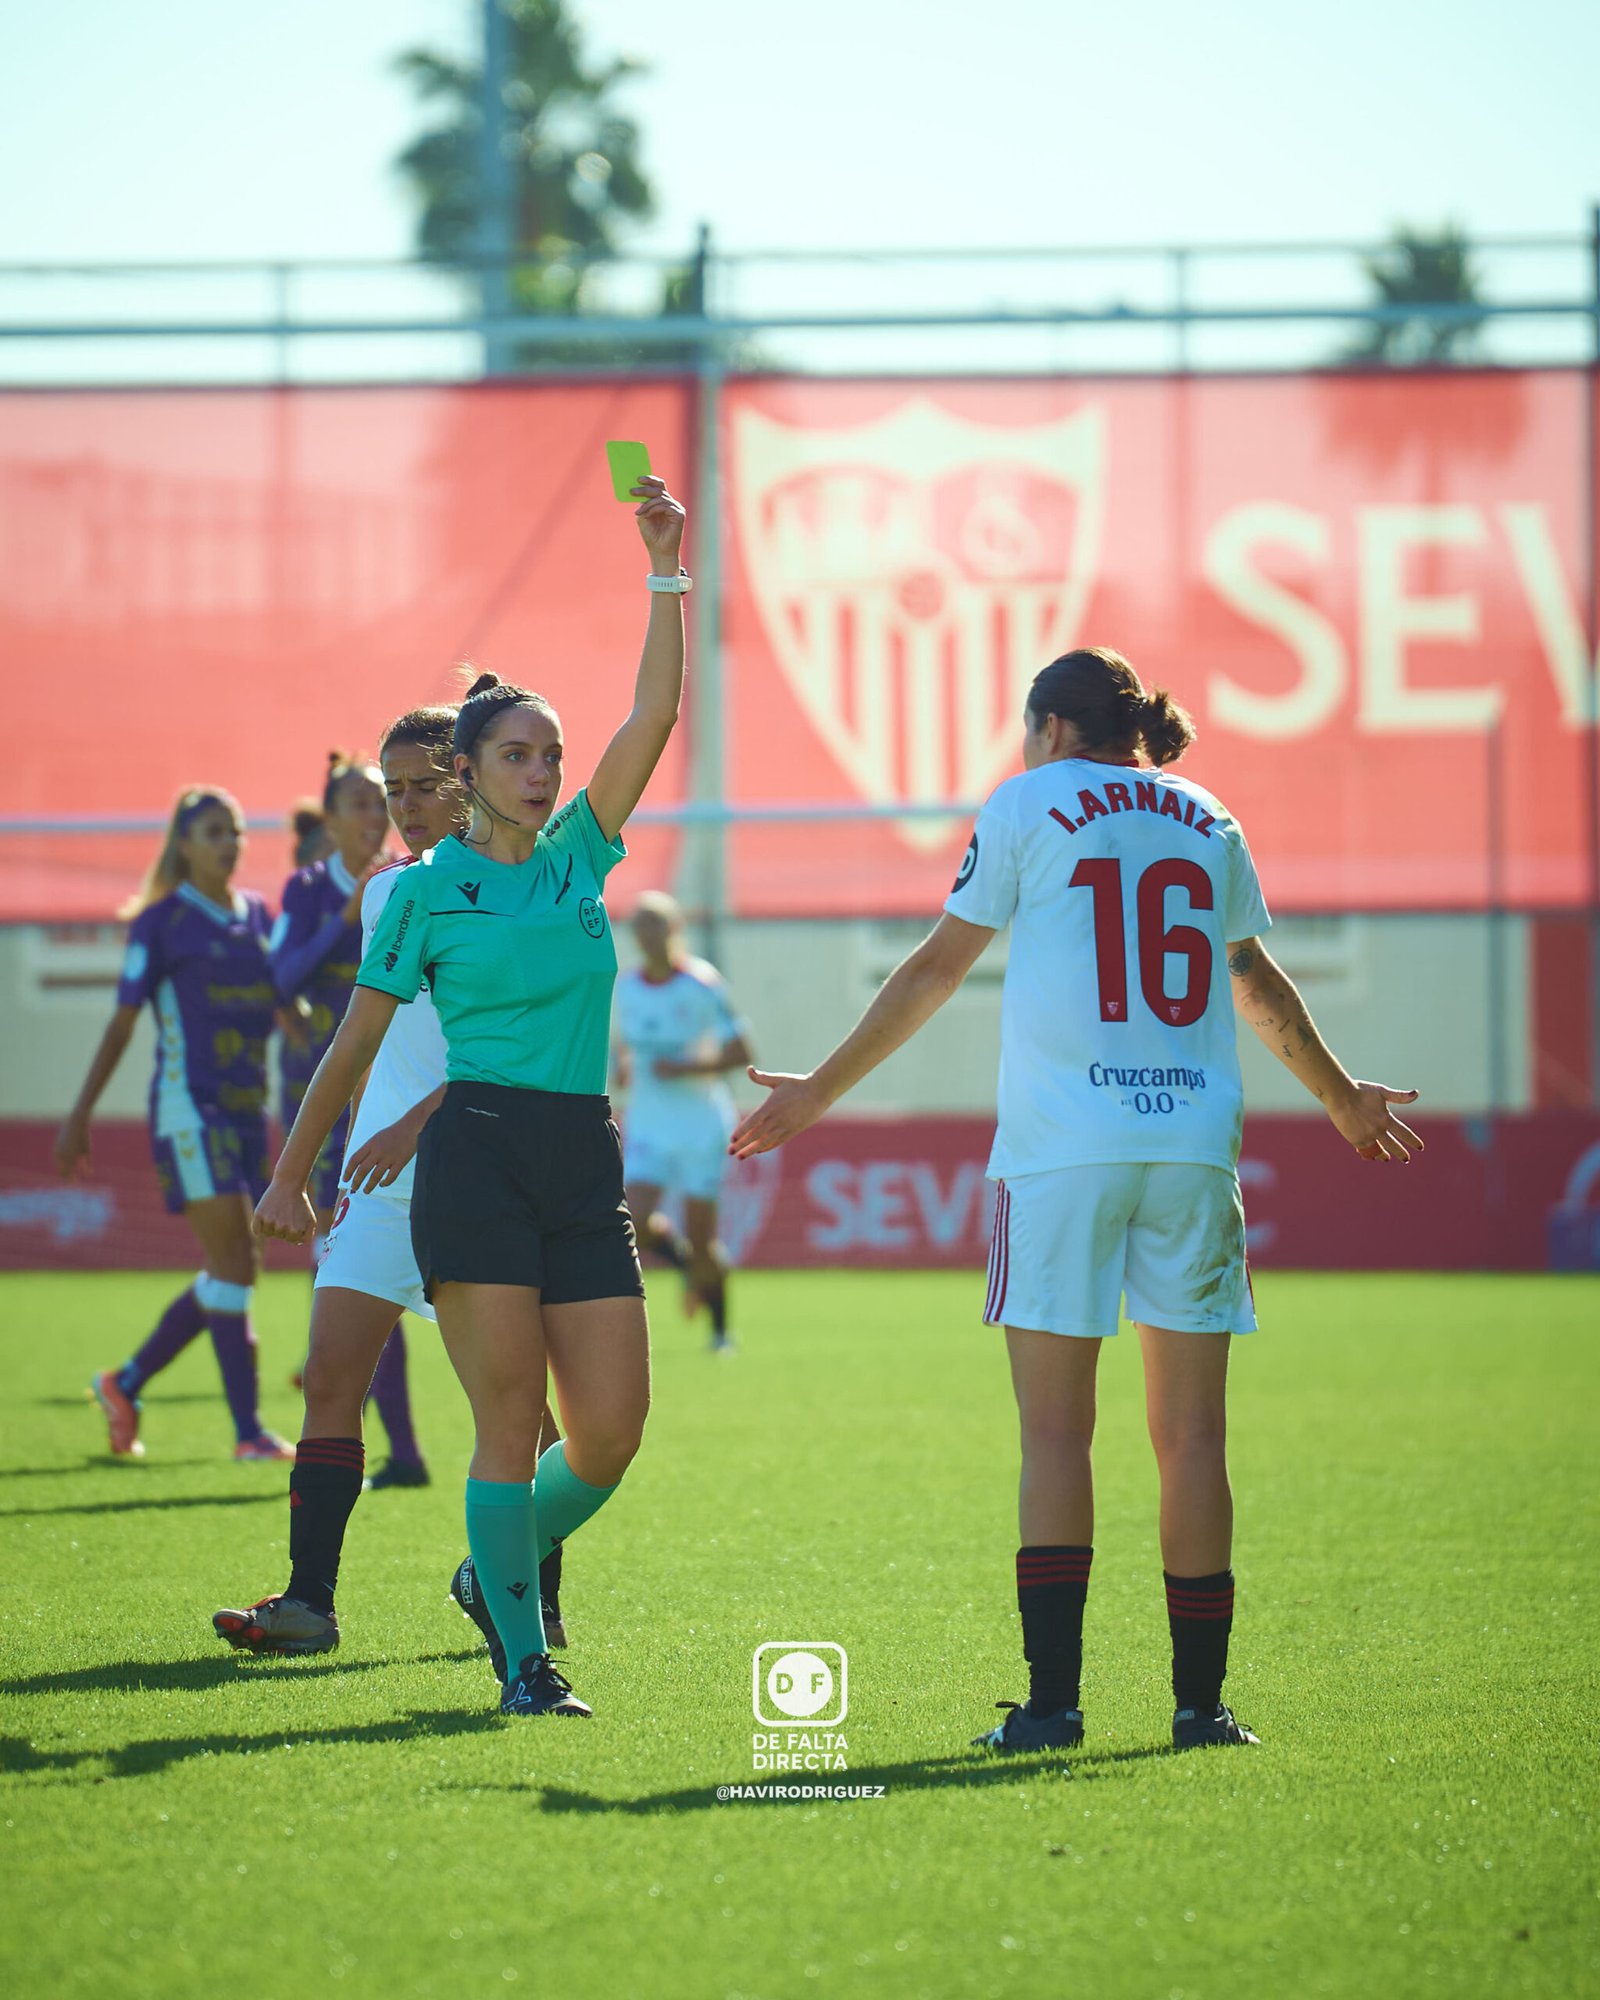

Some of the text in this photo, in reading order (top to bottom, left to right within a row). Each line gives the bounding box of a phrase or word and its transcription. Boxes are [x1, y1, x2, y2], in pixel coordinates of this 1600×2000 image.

[1048, 781, 1216, 838] I.ARNAIZ
[392, 899, 415, 951] Iberdrola
[1068, 858, 1214, 1027] 16
[1089, 1061, 1206, 1091] Cruzcampo
[1134, 1092, 1175, 1115] 0.0
